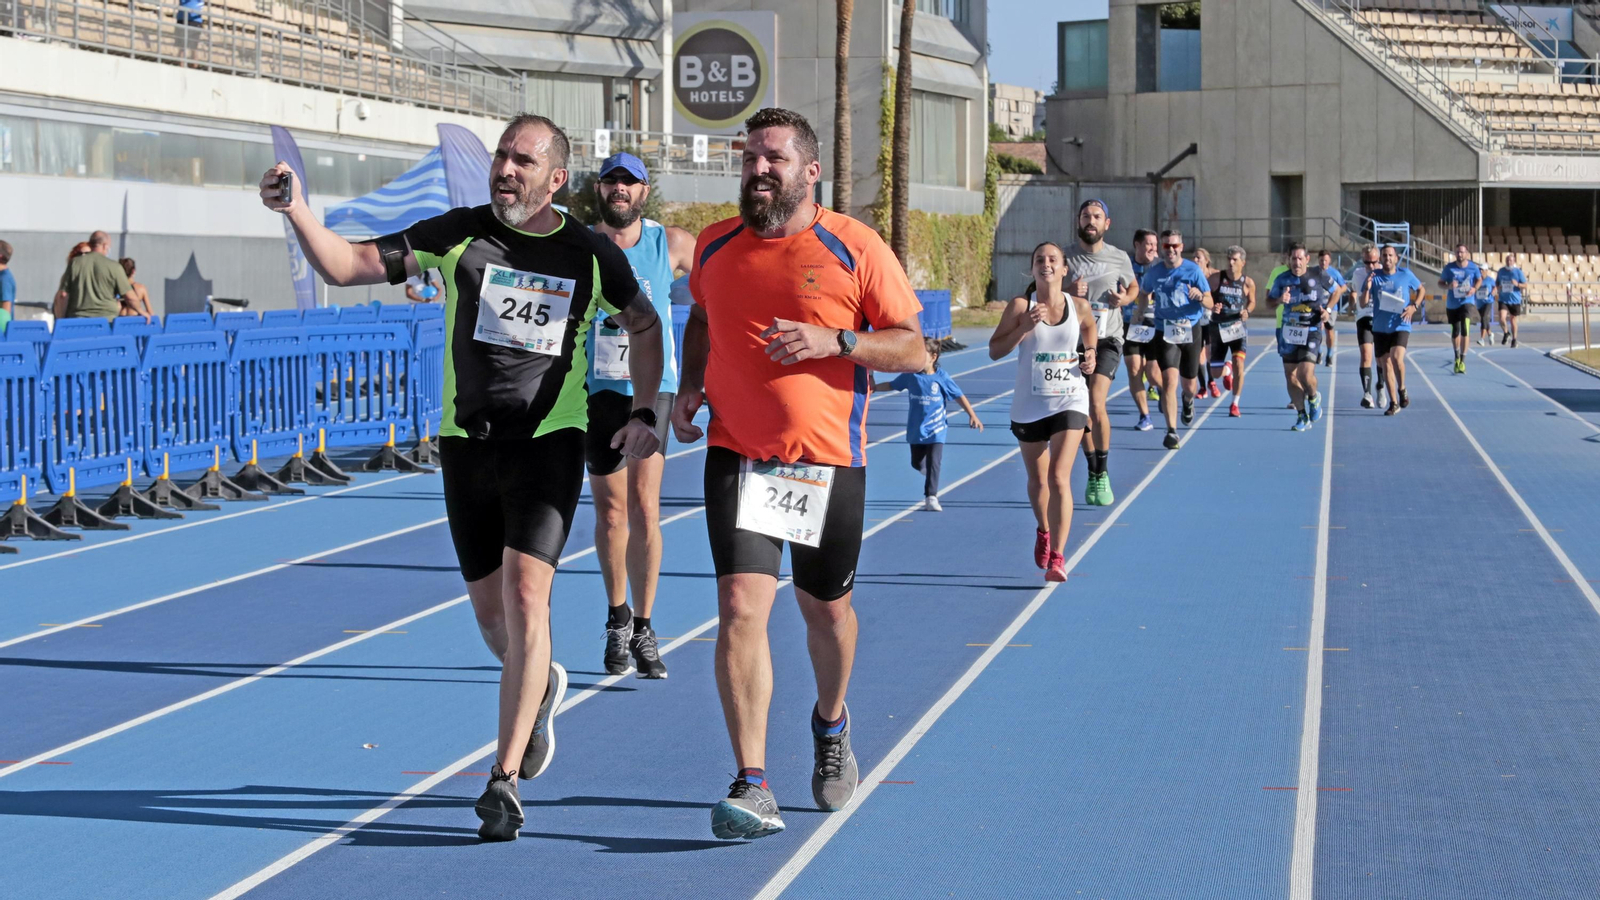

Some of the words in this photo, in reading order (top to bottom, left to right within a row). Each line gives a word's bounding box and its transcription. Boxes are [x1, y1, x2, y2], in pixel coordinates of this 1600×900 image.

[679, 54, 757, 88] B&B
[690, 90, 745, 103] HOTELS
[1514, 158, 1588, 180] Cruzcampo
[499, 297, 551, 327] 245
[1288, 328, 1303, 338] 784
[617, 344, 629, 361] 7
[1044, 368, 1070, 381] 842
[763, 486, 808, 517] 244
